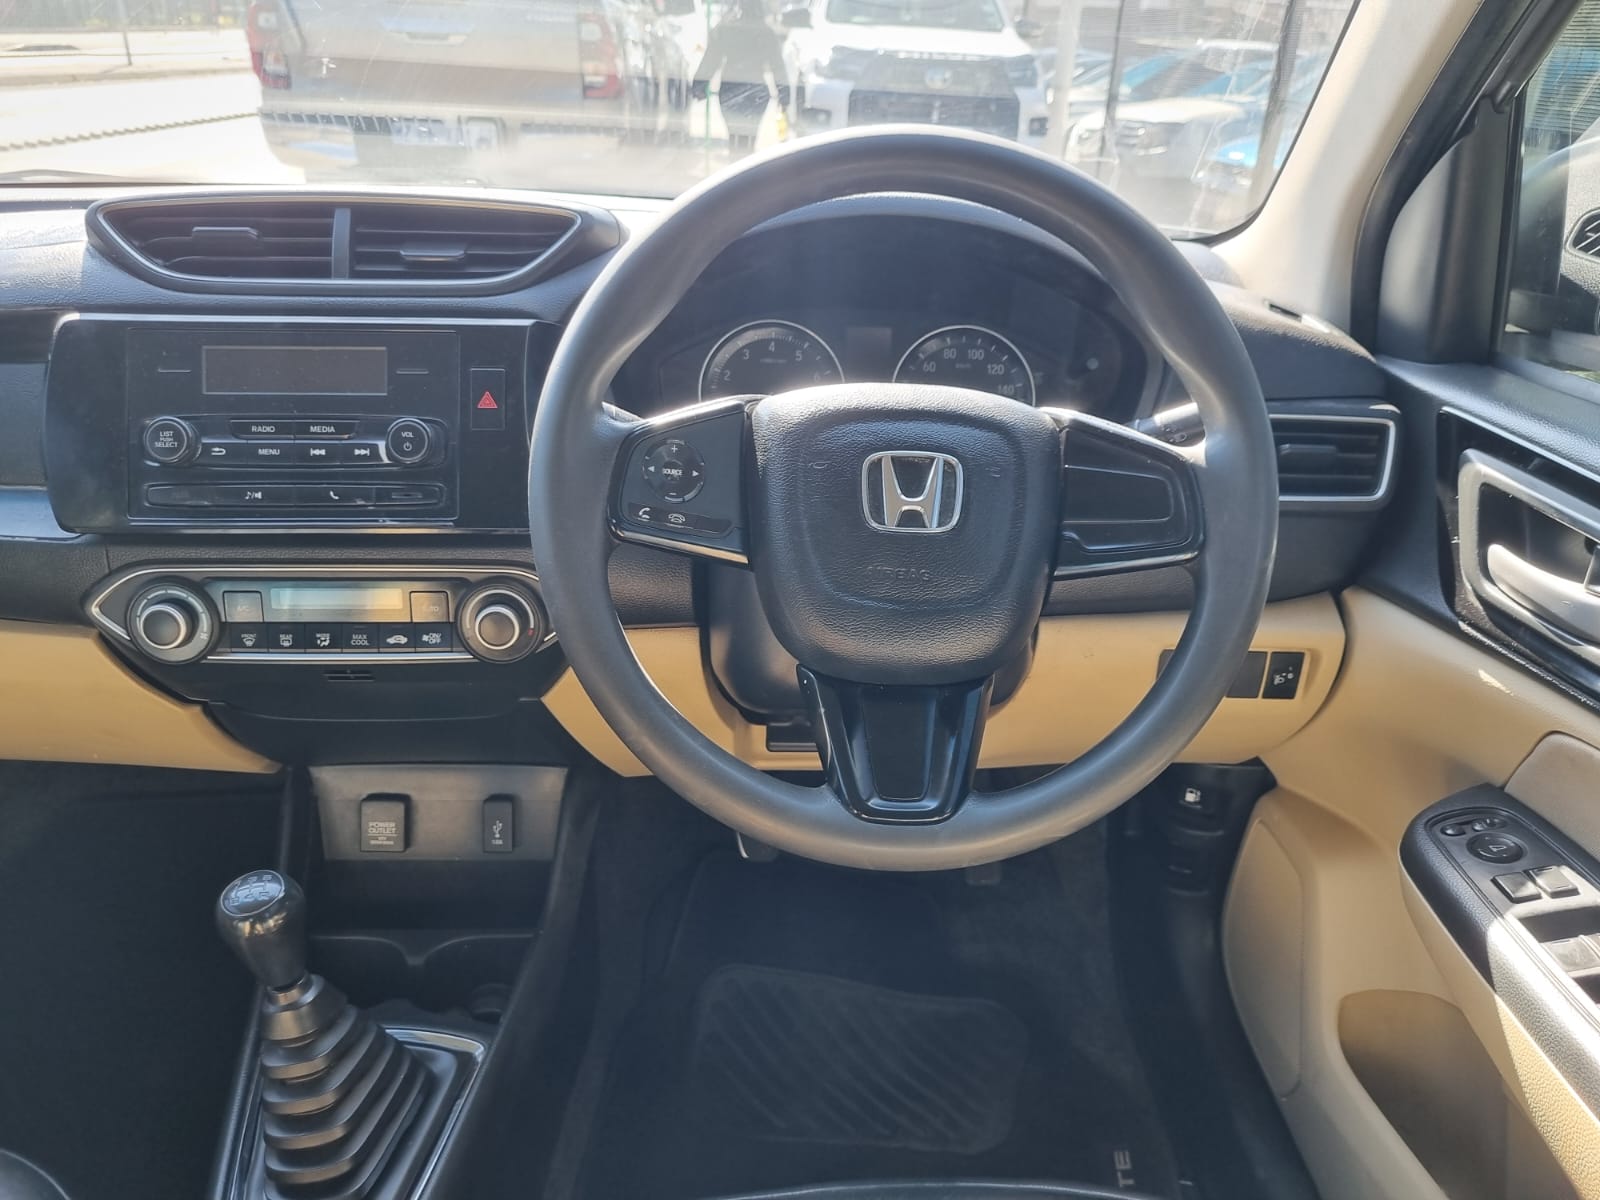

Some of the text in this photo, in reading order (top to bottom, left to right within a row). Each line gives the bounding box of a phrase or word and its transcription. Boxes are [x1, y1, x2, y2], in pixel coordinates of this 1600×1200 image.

[769, 341, 776, 353] 4
[743, 349, 750, 360] 3
[795, 350, 803, 361] 5
[943, 348, 957, 359] 80
[967, 348, 984, 360] 100
[922, 361, 936, 373] 60
[987, 364, 1005, 375] 120
[723, 370, 731, 381] 2
[251, 425, 276, 433] RADIO
[309, 425, 336, 433] MEDIA
[258, 448, 280, 456] MENU
[662, 468, 683, 476] SOURCE
